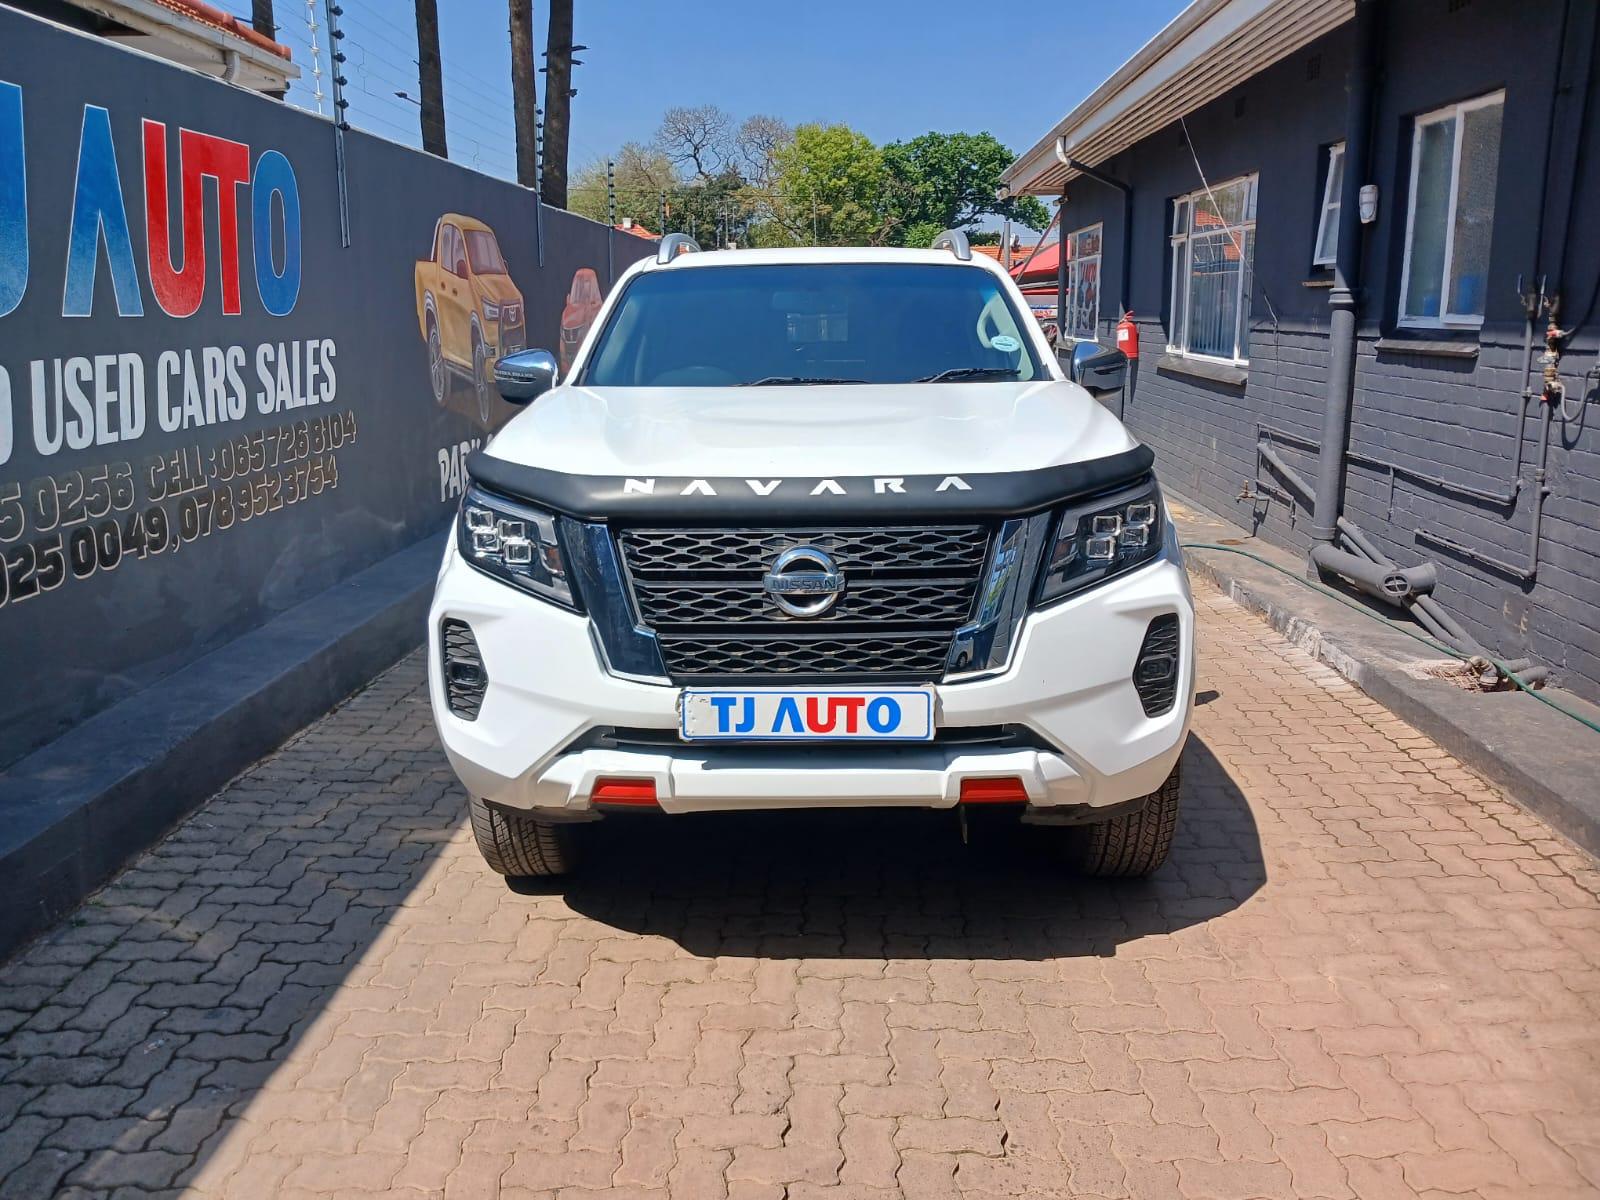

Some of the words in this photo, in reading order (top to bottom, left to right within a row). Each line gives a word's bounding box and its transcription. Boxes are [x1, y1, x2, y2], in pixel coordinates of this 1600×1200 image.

[62, 103, 301, 318] AUTO
[30, 352, 146, 456] USED
[157, 345, 247, 433] CARS
[256, 338, 337, 415] SALES
[31, 461, 135, 532] 0256
[623, 476, 972, 496] NAVARA
[772, 579, 837, 590] NISSAN
[710, 697, 755, 733] TJ
[771, 697, 902, 733] AUTO
